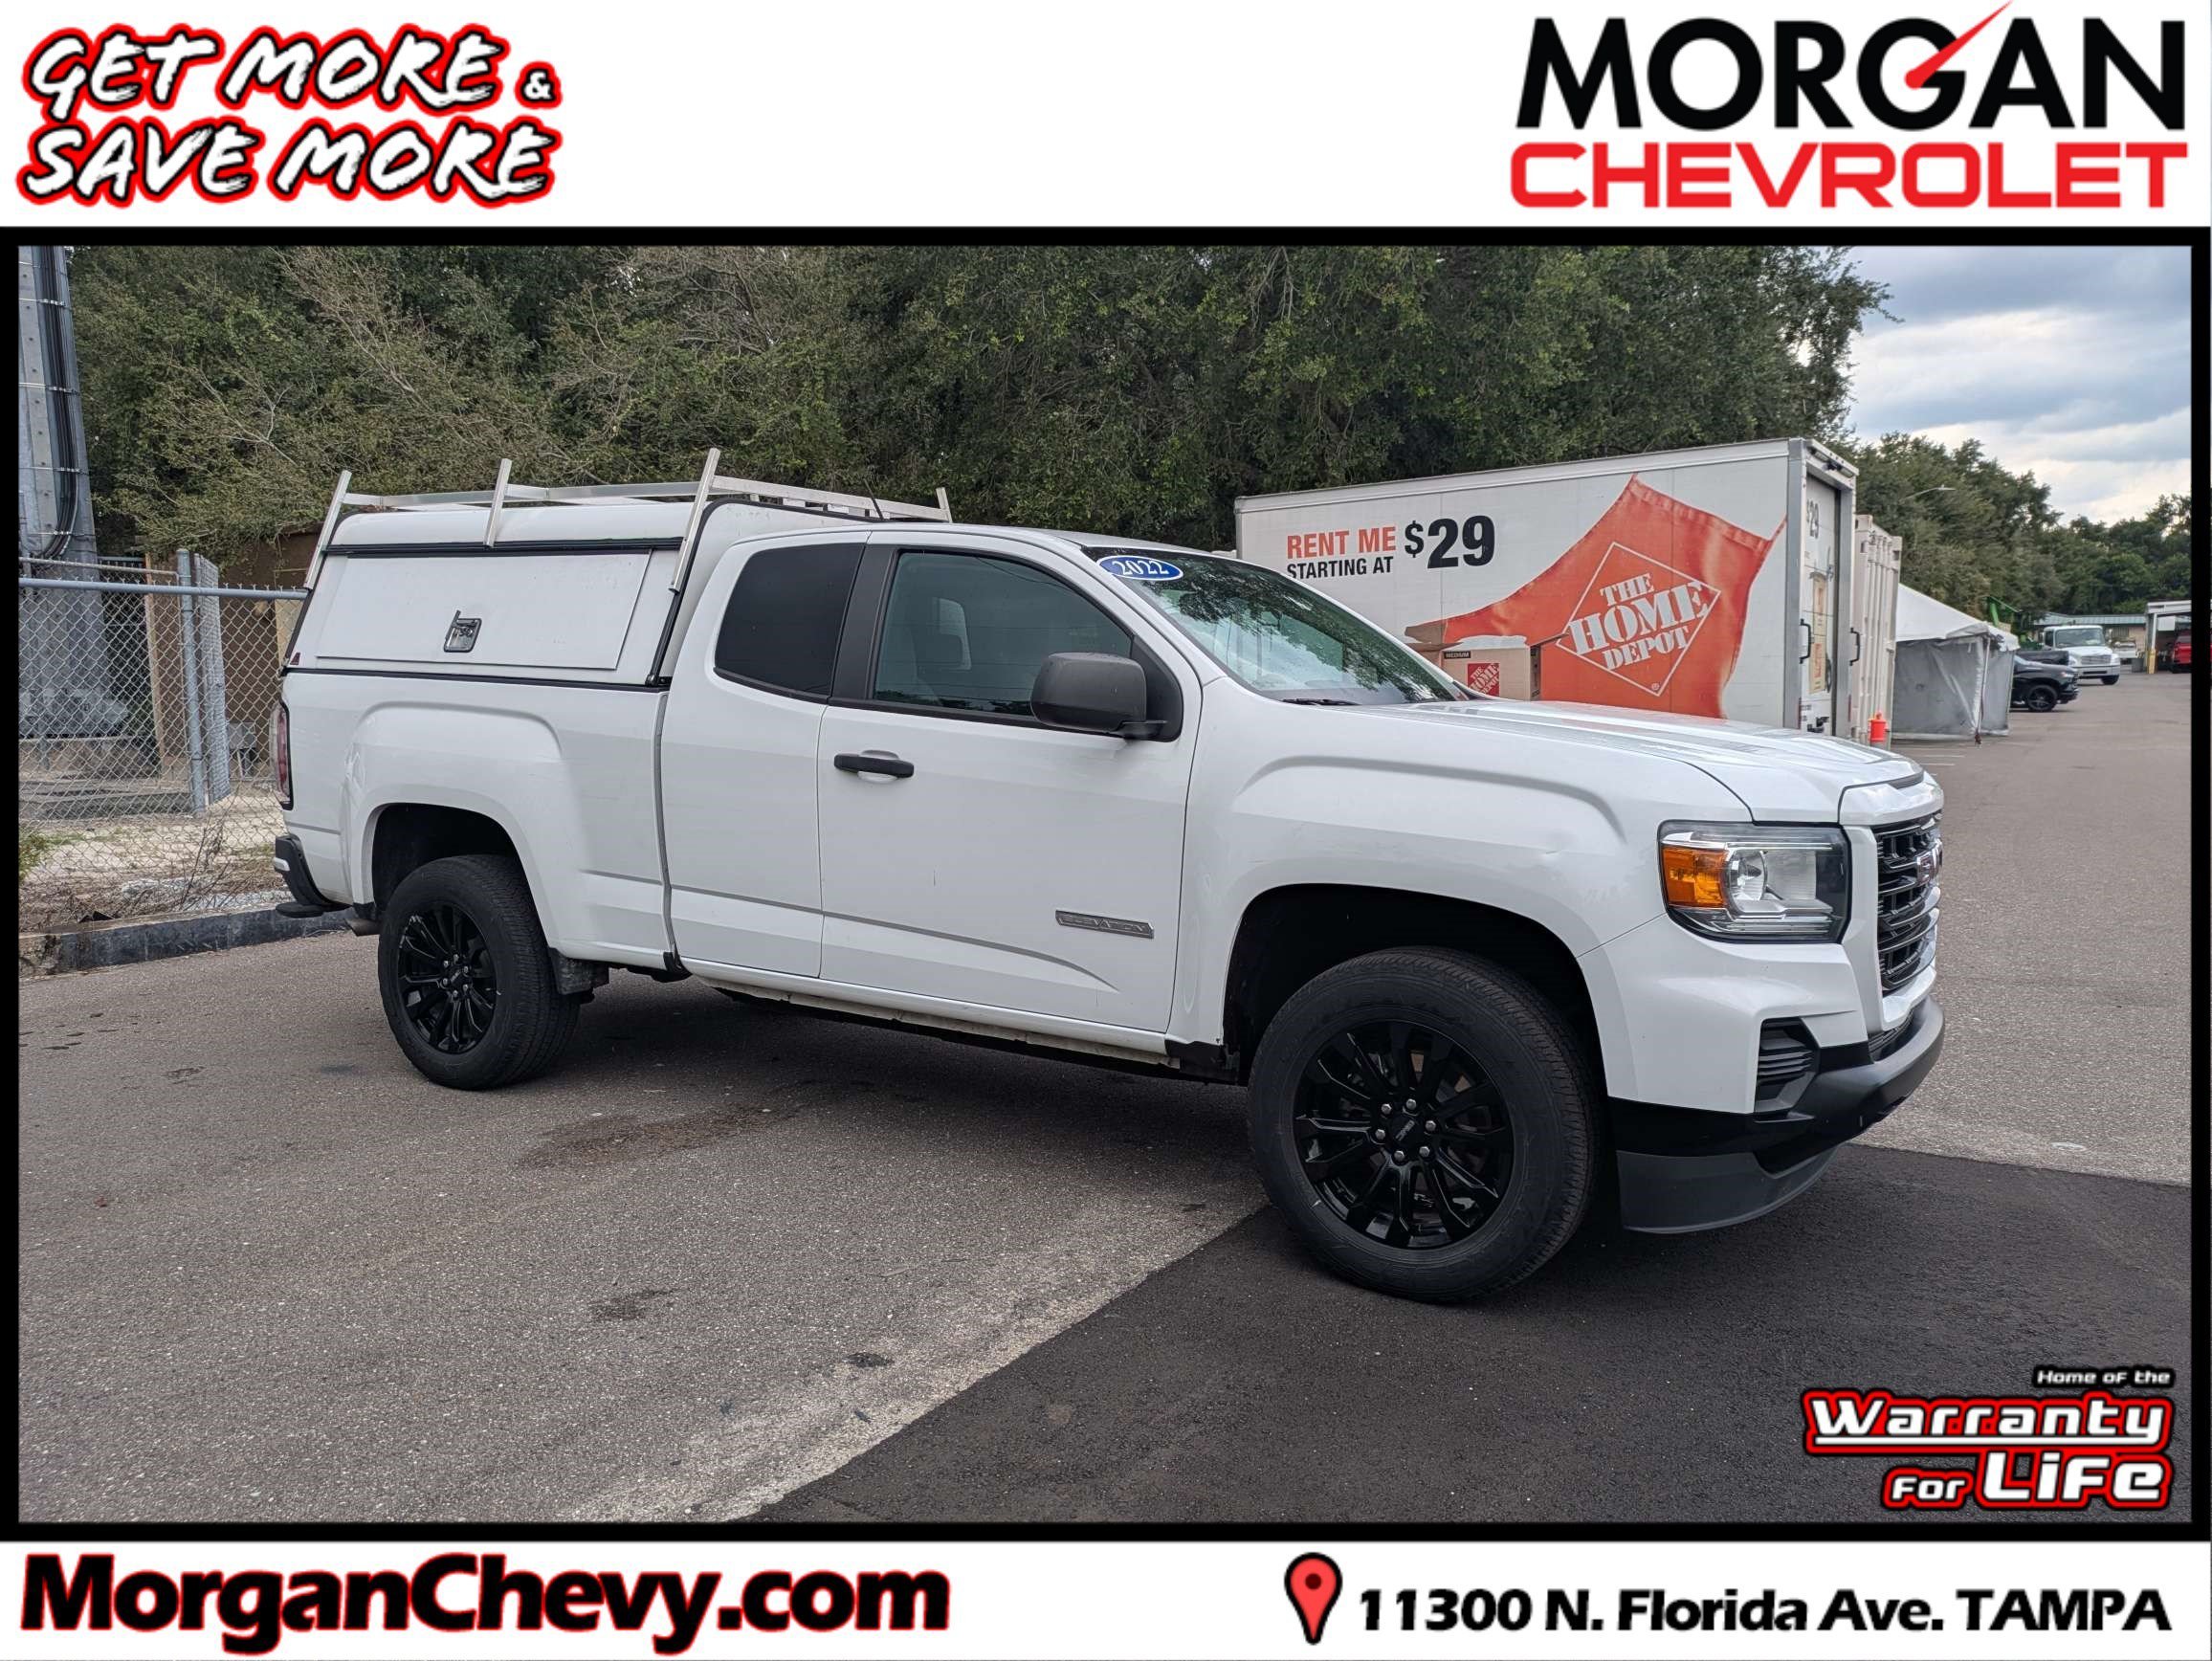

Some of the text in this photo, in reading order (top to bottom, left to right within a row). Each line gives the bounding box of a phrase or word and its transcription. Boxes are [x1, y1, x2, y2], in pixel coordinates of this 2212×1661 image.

[1286, 525, 1397, 560] RENT ME
[1404, 515, 1495, 569] $29
[1111, 560, 1170, 576] 2022
[1286, 555, 1395, 580] STARTING AT
[1599, 572, 1655, 608] THE
[1567, 580, 1710, 655] HOME
[1601, 625, 1691, 671] DEPOT
